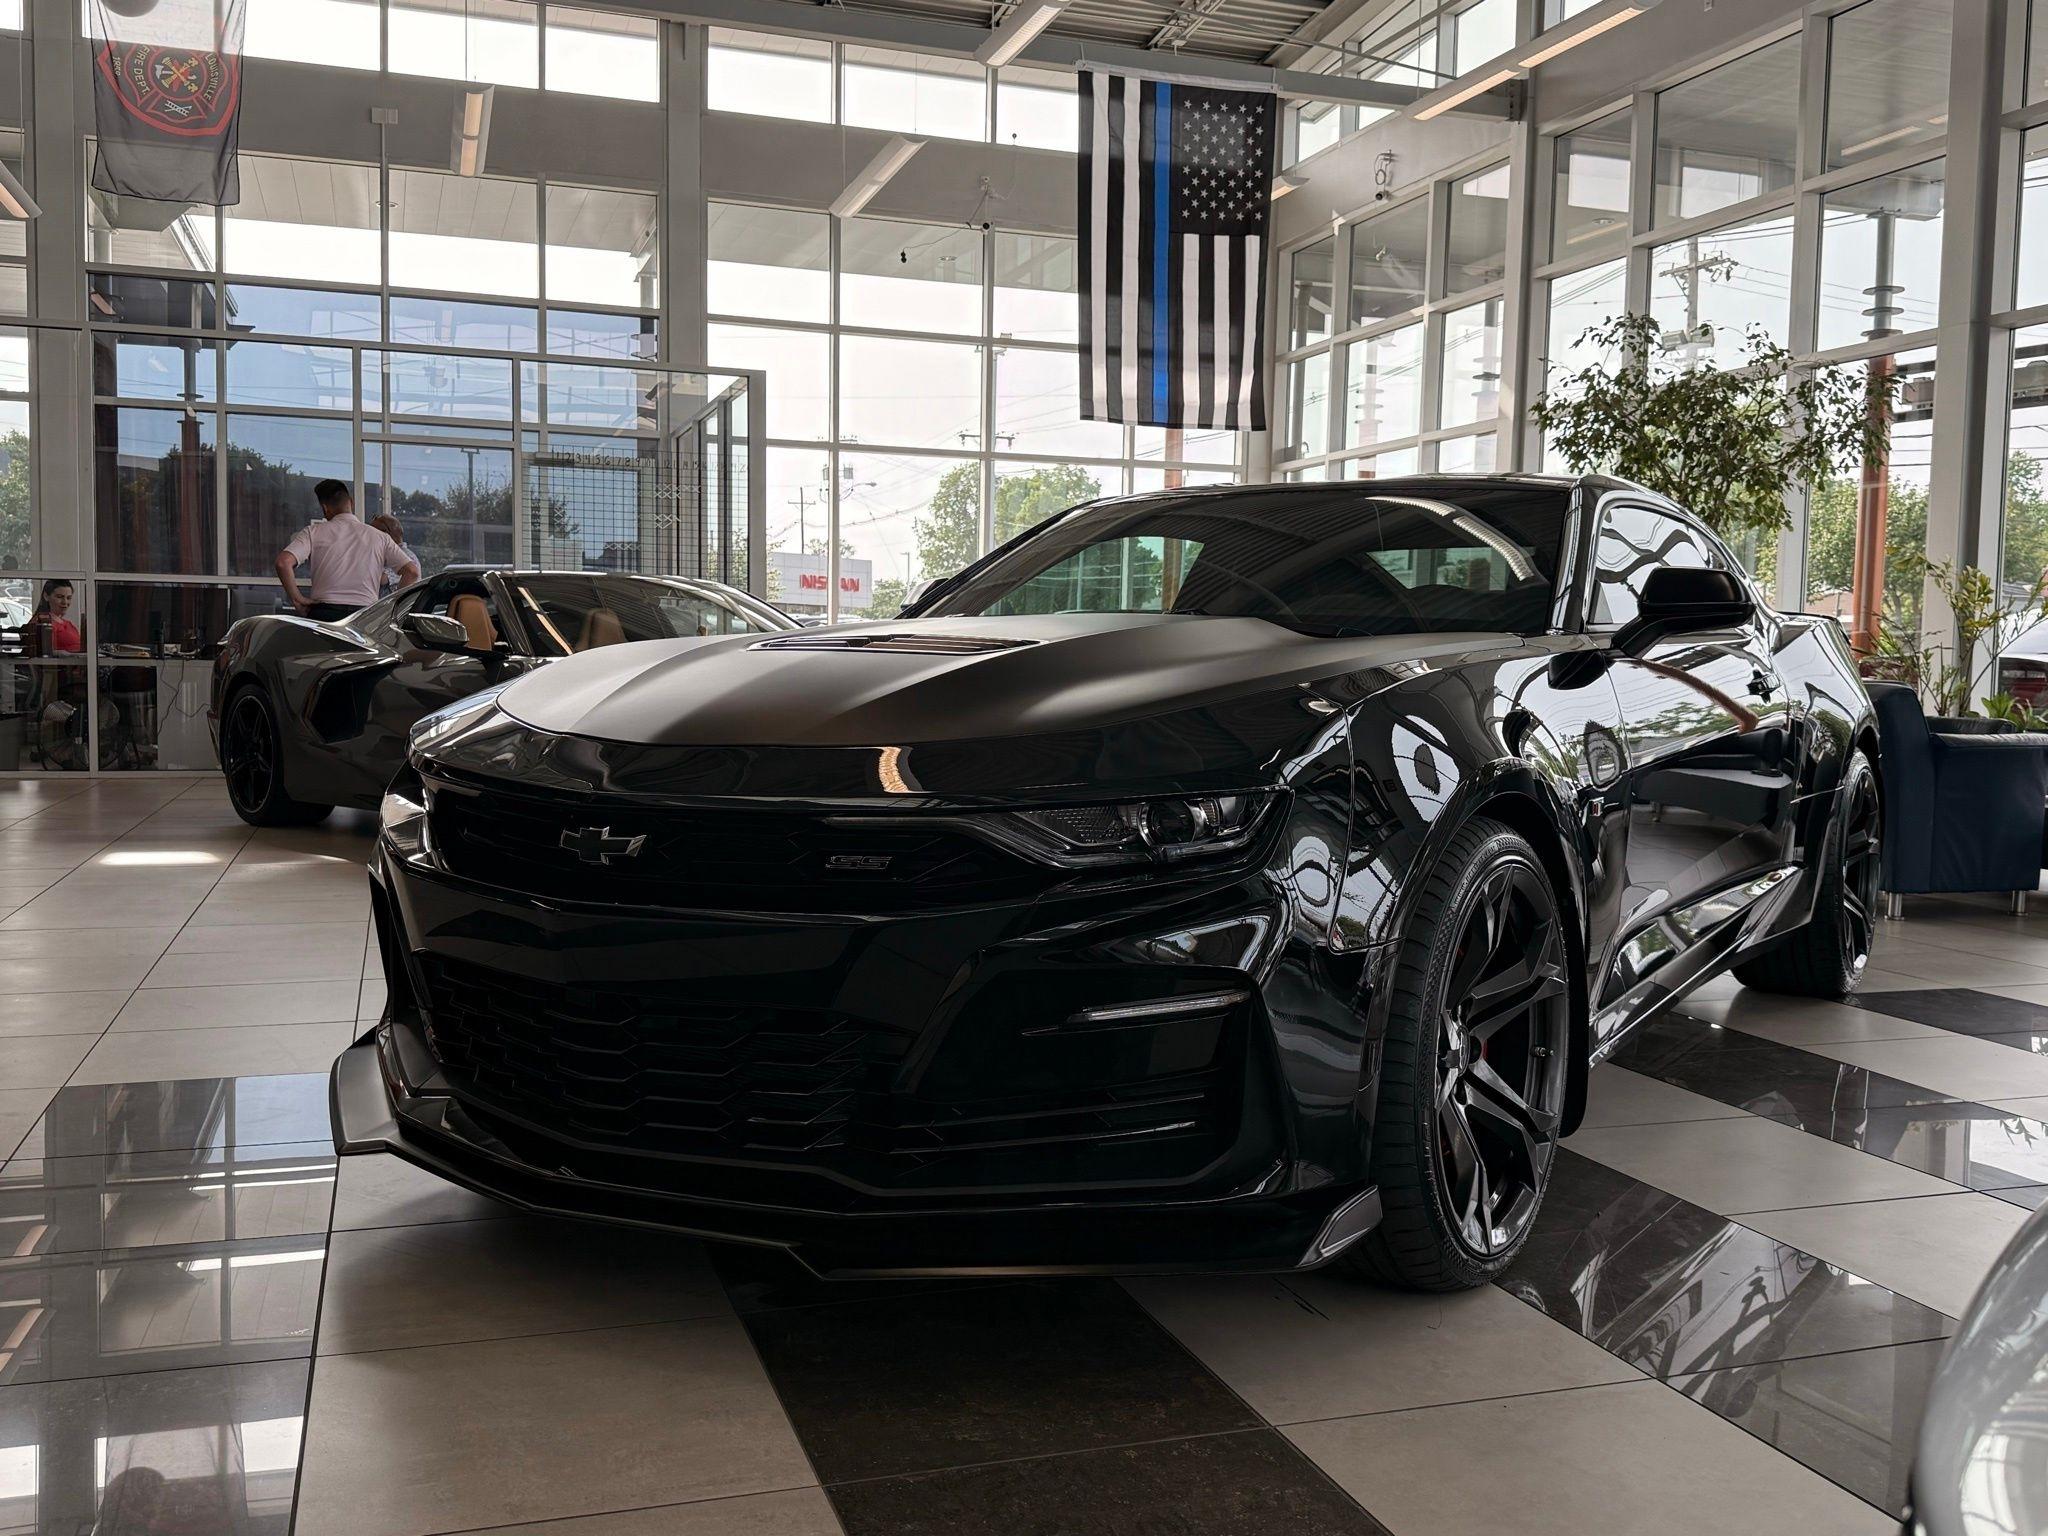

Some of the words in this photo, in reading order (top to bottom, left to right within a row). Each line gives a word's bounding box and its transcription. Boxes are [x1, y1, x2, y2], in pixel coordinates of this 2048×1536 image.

[134, 45, 151, 66] FIRE
[133, 68, 151, 95] DEPT.
[204, 53, 219, 100] LOUISVILLE
[801, 574, 860, 592] NISAN
[825, 855, 893, 870] SS
